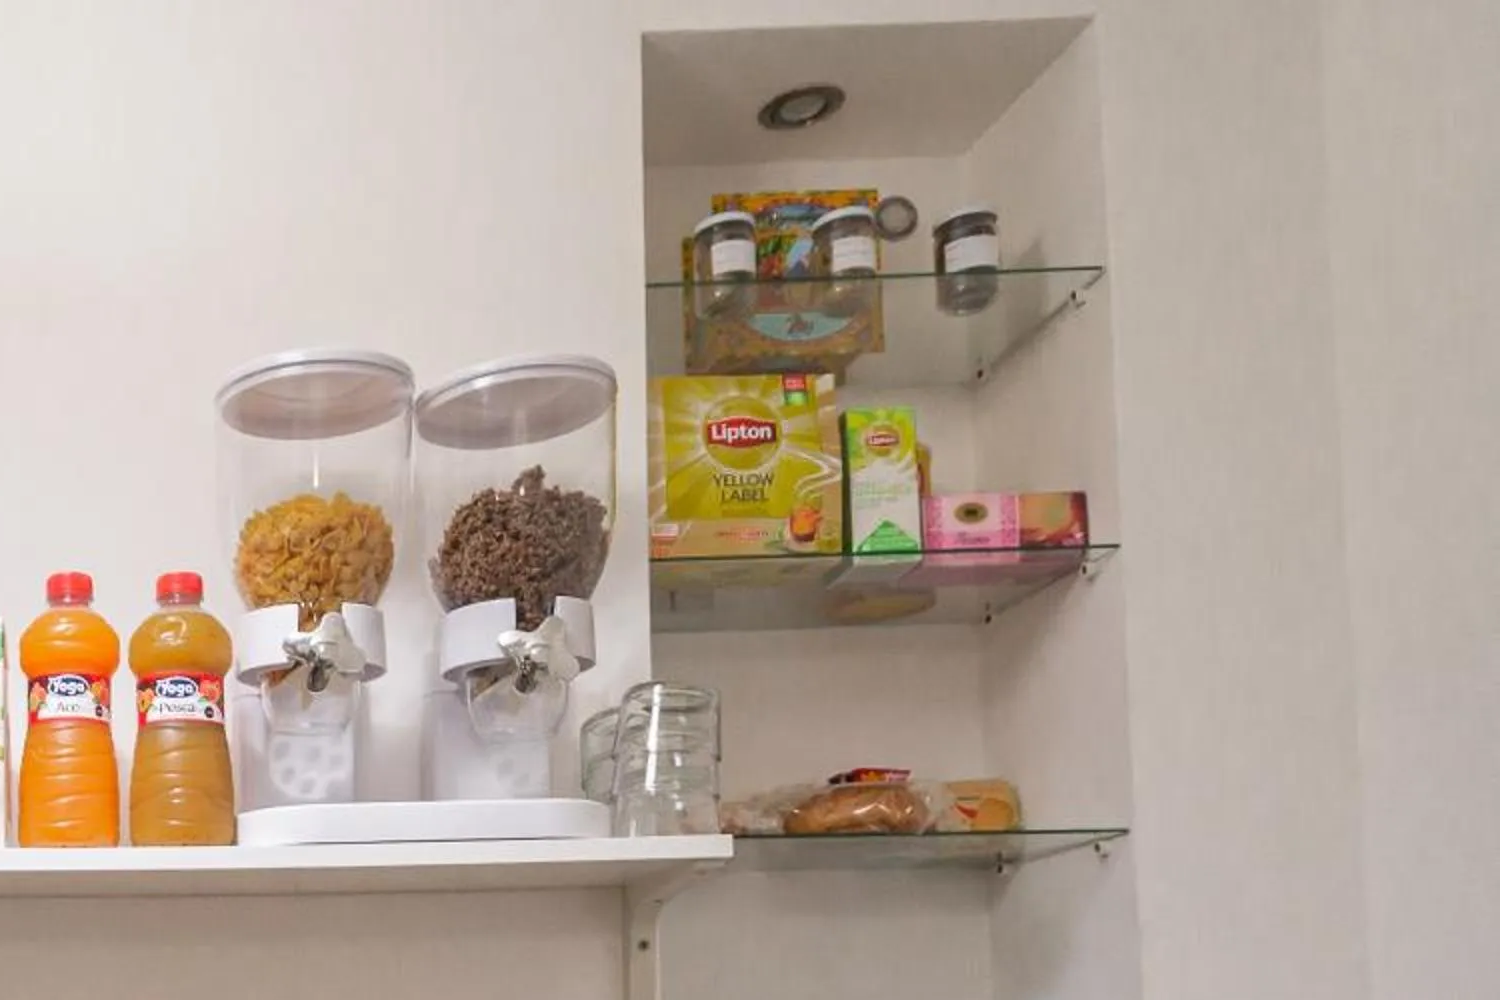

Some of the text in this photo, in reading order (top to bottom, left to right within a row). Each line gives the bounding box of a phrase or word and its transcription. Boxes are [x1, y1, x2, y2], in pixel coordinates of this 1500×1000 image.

[711, 423, 773, 444] Lipton
[712, 471, 775, 487] YELLOW
[720, 487, 770, 503] LABEL
[48, 677, 86, 695] Yoga
[156, 679, 195, 697] Yoga
